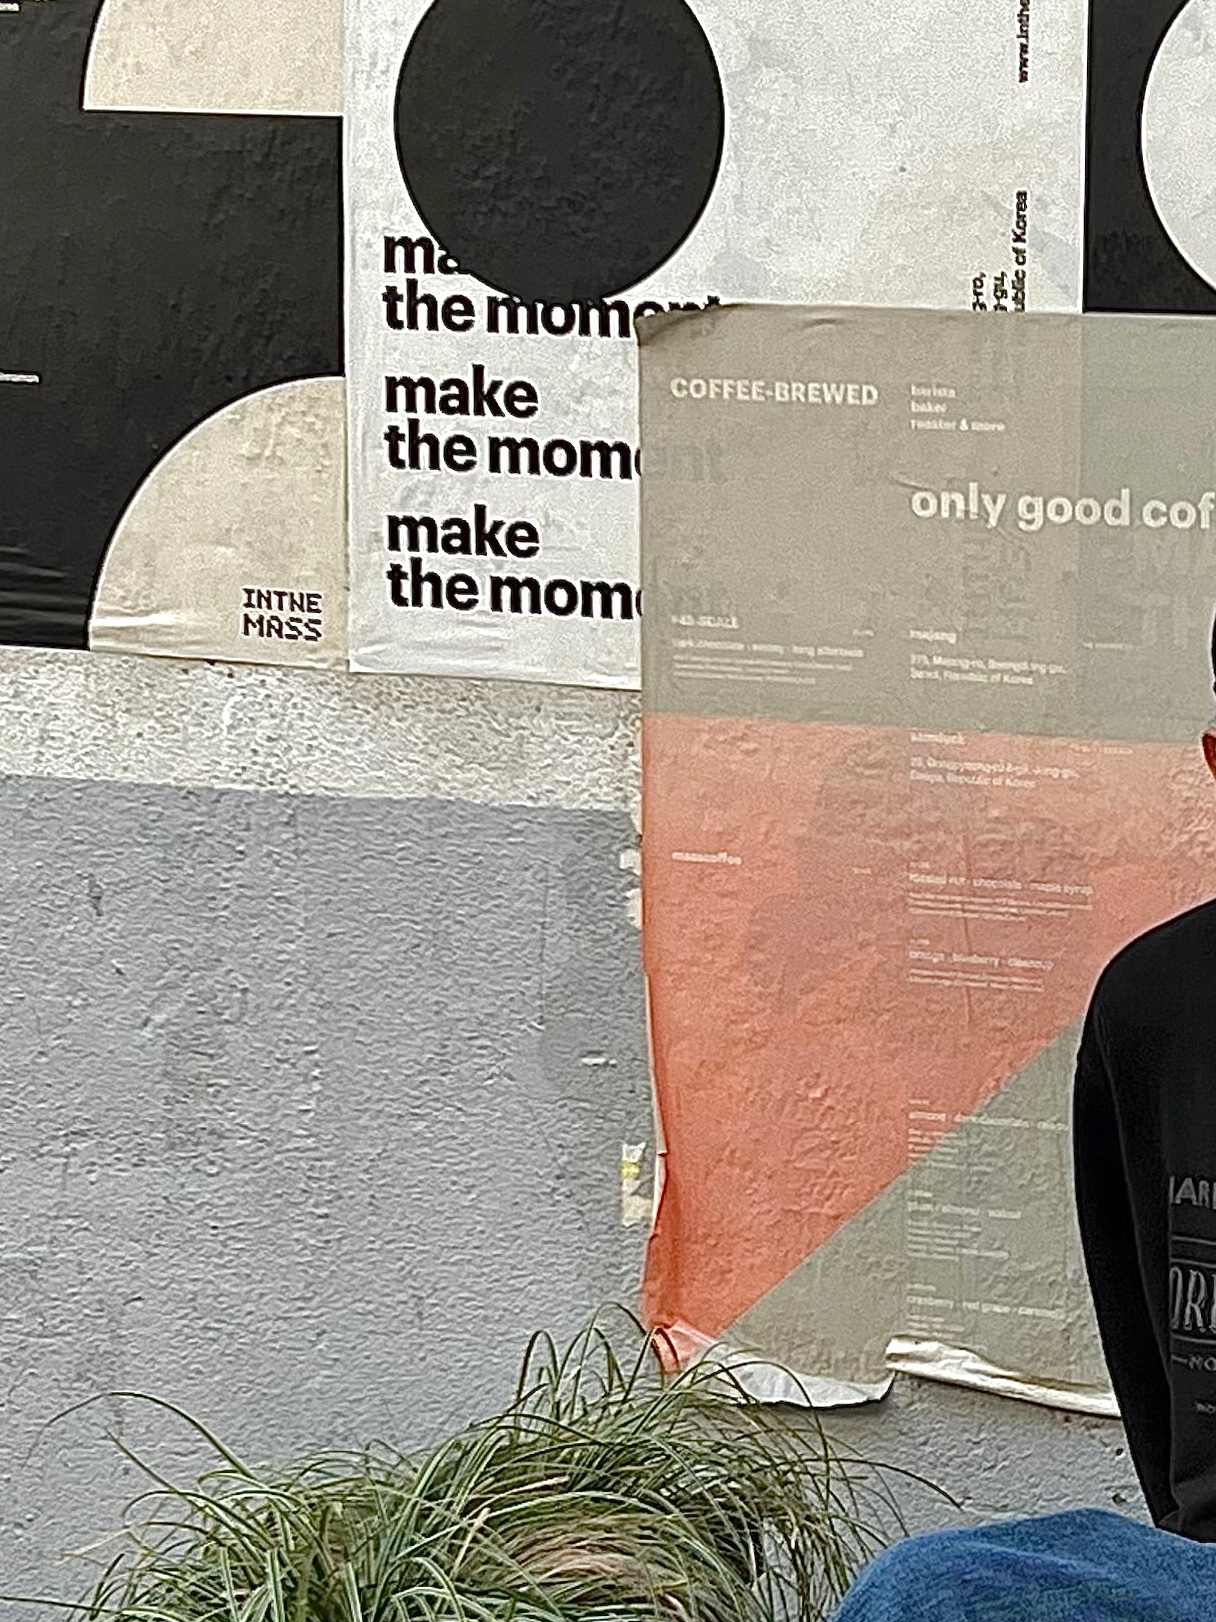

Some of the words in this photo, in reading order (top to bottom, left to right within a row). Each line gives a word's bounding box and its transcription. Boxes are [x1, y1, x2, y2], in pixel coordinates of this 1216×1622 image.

[1012, 190, 1028, 244] Korea
[382, 278, 476, 331] the
[385, 363, 539, 418] make
[670, 377, 880, 406] COFFEE-BREWED
[384, 418, 478, 472] the
[488, 436, 642, 480] mom
[959, 418, 969, 431] &
[387, 503, 540, 558] make
[911, 482, 1006, 529] only
[1017, 488, 1131, 532] good
[386, 557, 479, 610] the
[490, 575, 643, 620] mom
[242, 614, 323, 641] MASS
